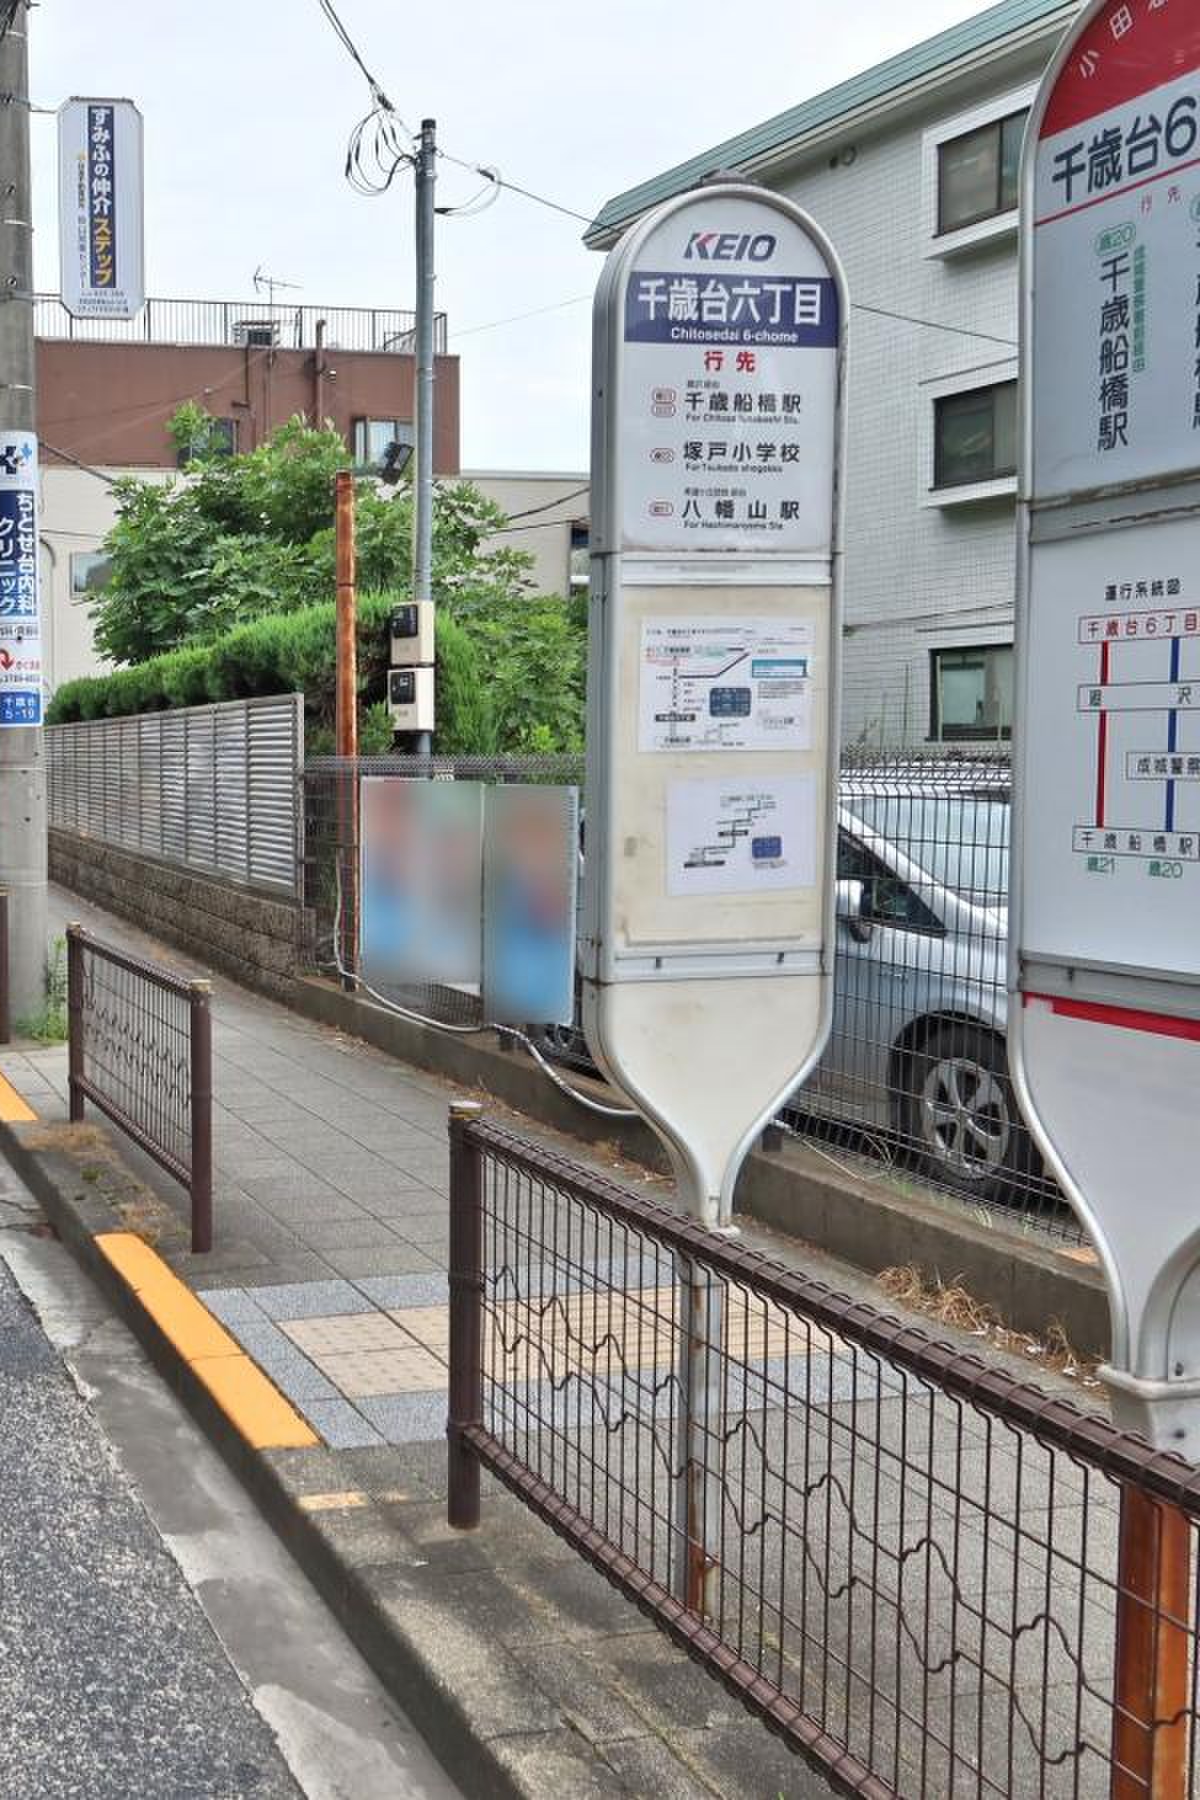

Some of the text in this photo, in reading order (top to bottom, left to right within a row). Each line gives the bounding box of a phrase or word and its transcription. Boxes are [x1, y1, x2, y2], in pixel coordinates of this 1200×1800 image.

[1052, 96, 1197, 202] 千歳台6
[91, 107, 112, 286] すみふの仲介ステップ
[684, 232, 777, 262] KEIO
[638, 278, 821, 325] 千歳台六丁目
[671, 326, 799, 344] Chitosedai 6-chome
[704, 351, 756, 373] 行先
[1097, 254, 1130, 450] 千歳船橋駅
[684, 391, 801, 413] 千歳船橋駅
[683, 442, 800, 463] 塚戸小学校
[682, 499, 800, 520] 八幡山駅
[17, 493, 34, 615] ちとせ台内科
[1087, 612, 1198, 638] 千歳台6丁目
